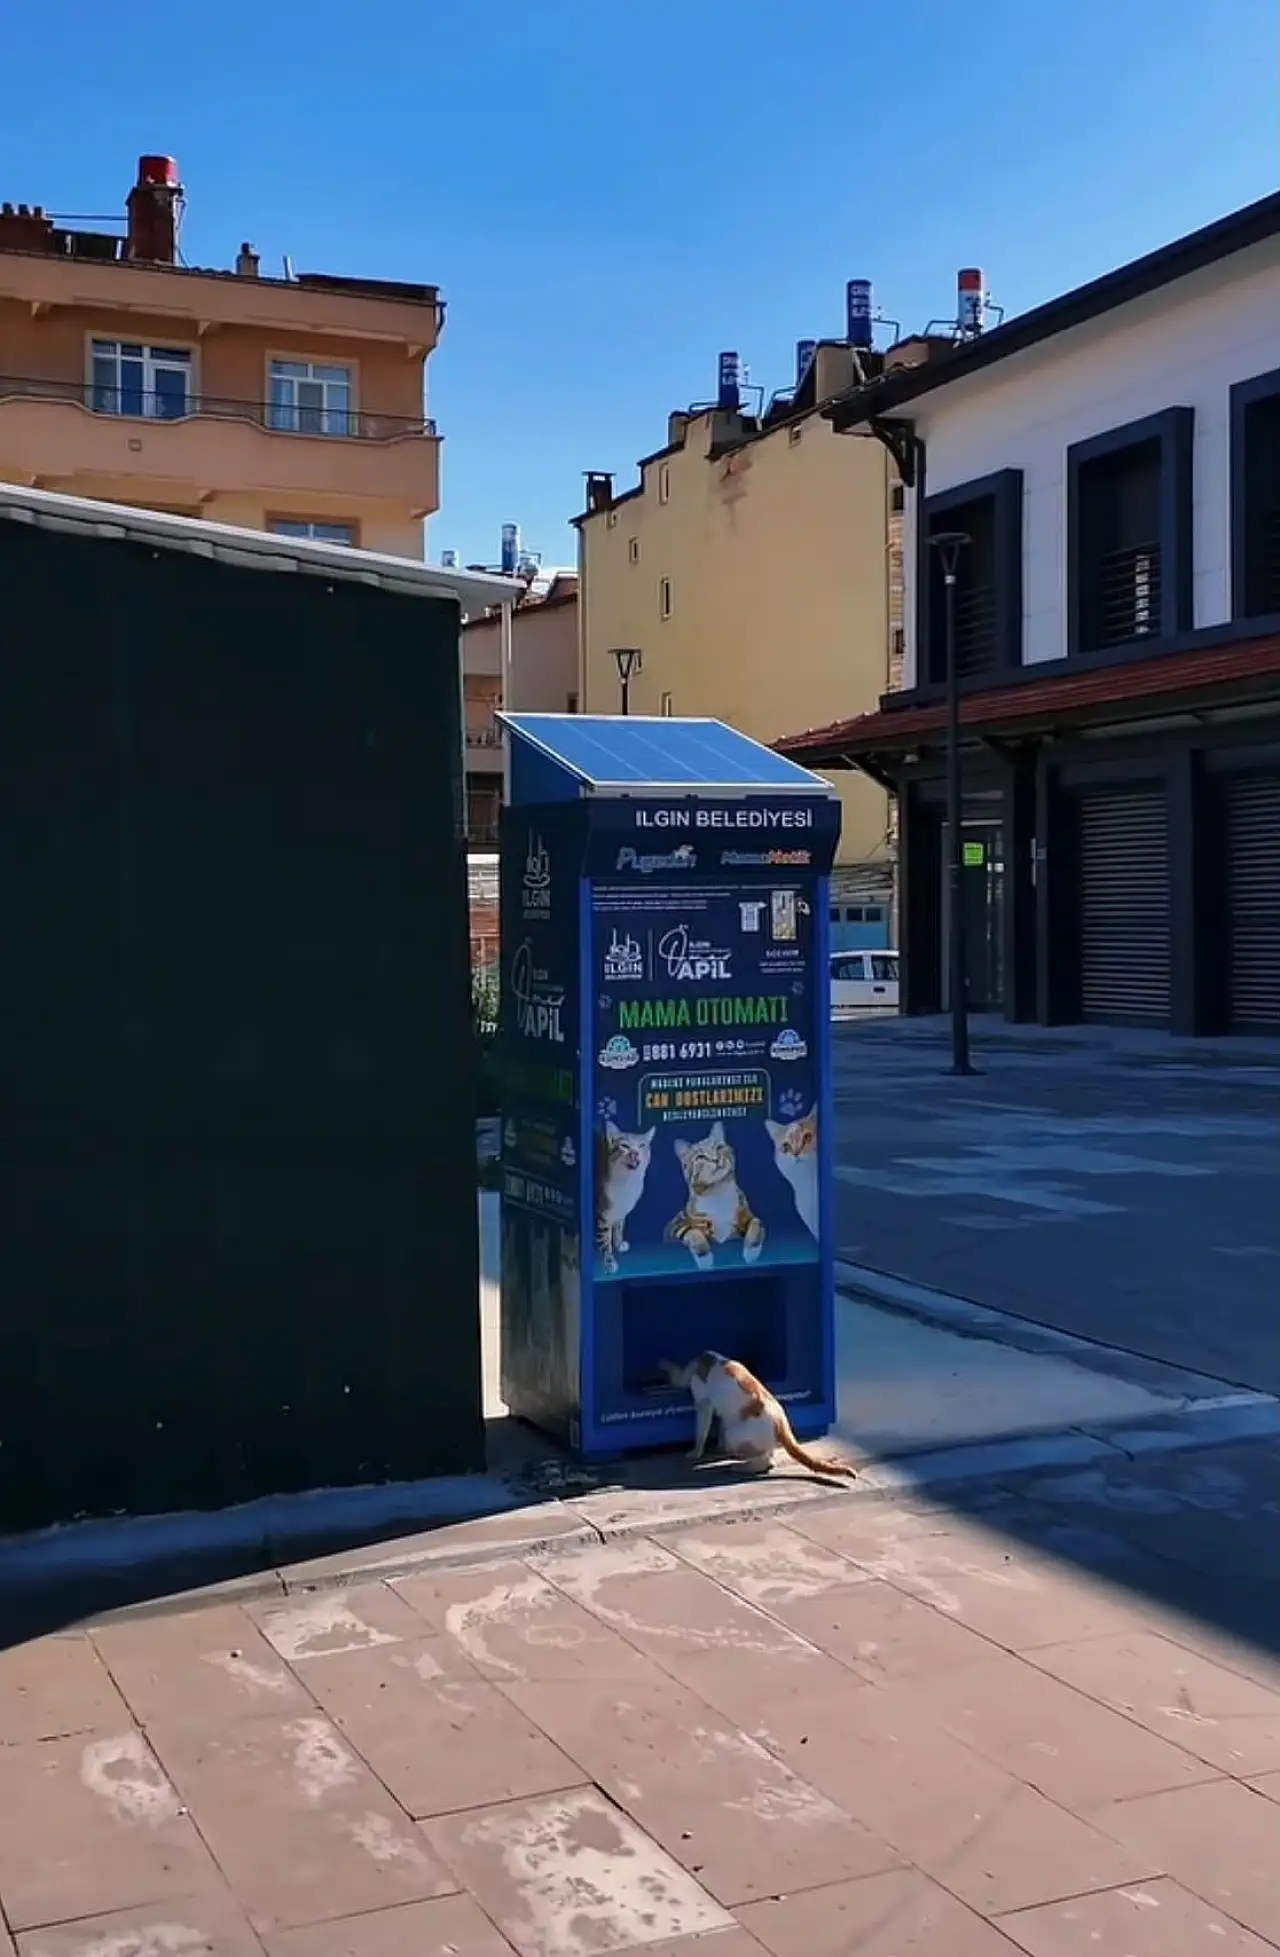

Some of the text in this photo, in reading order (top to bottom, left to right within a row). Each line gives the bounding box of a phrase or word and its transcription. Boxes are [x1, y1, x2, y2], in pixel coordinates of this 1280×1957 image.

[635, 807, 813, 827] ILGIN BELEDİYESİ
[619, 1000, 691, 1029] MAMA
[679, 1041, 711, 1060] 6931
